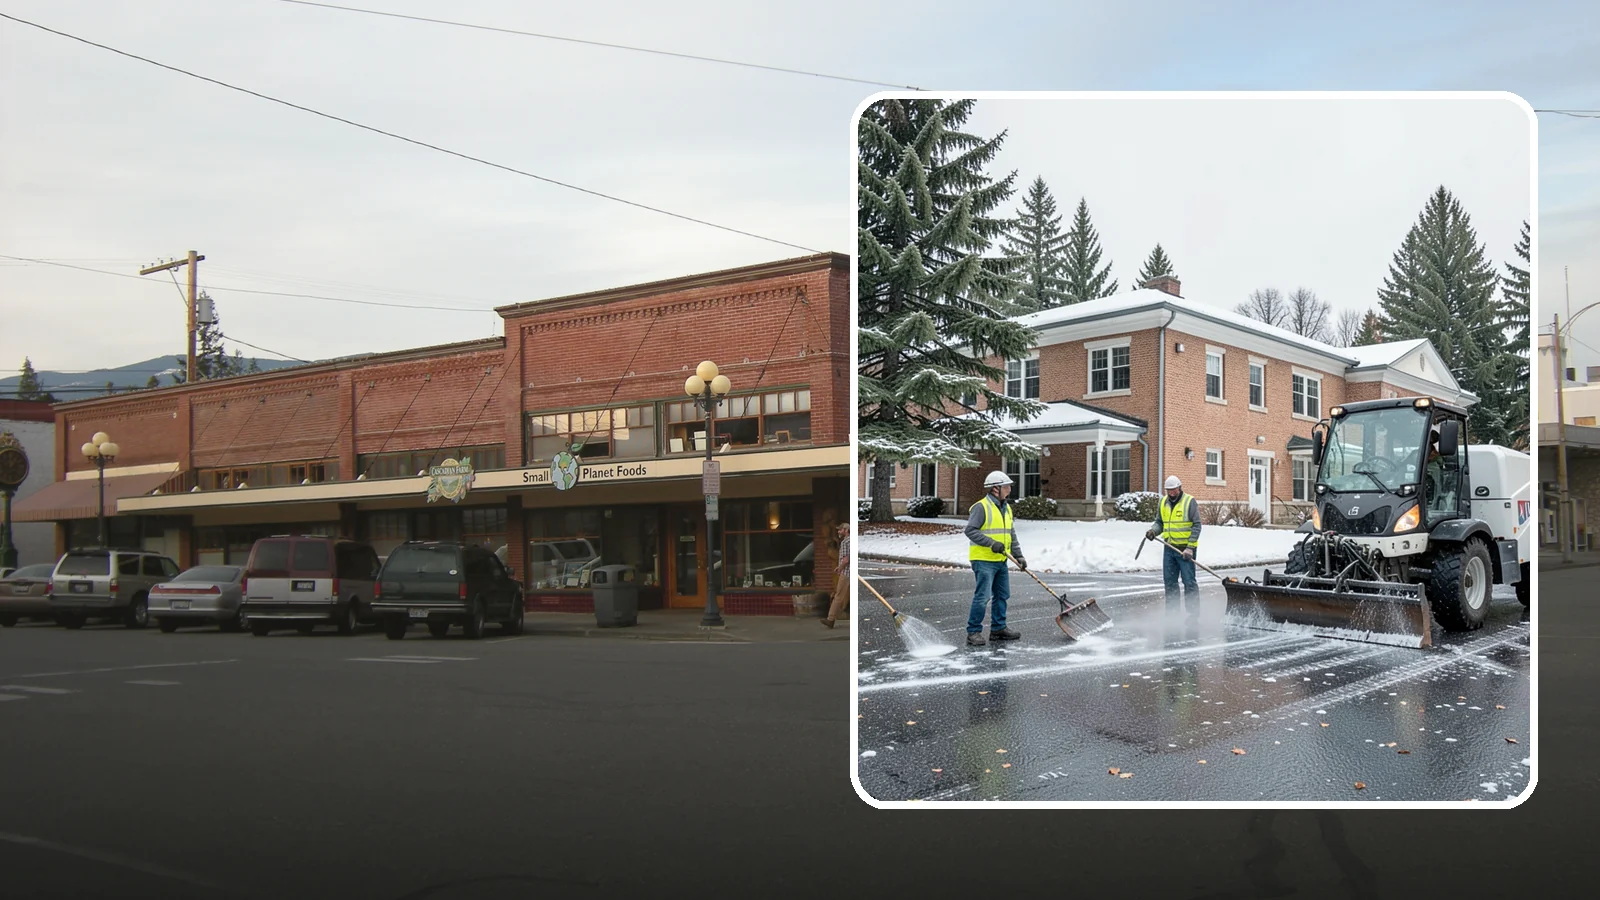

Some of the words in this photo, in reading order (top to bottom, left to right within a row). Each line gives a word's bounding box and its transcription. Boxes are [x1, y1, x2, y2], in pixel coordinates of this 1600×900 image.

[523, 471, 549, 483] Small
[582, 467, 614, 479] Planet
[616, 464, 647, 477] Foods
